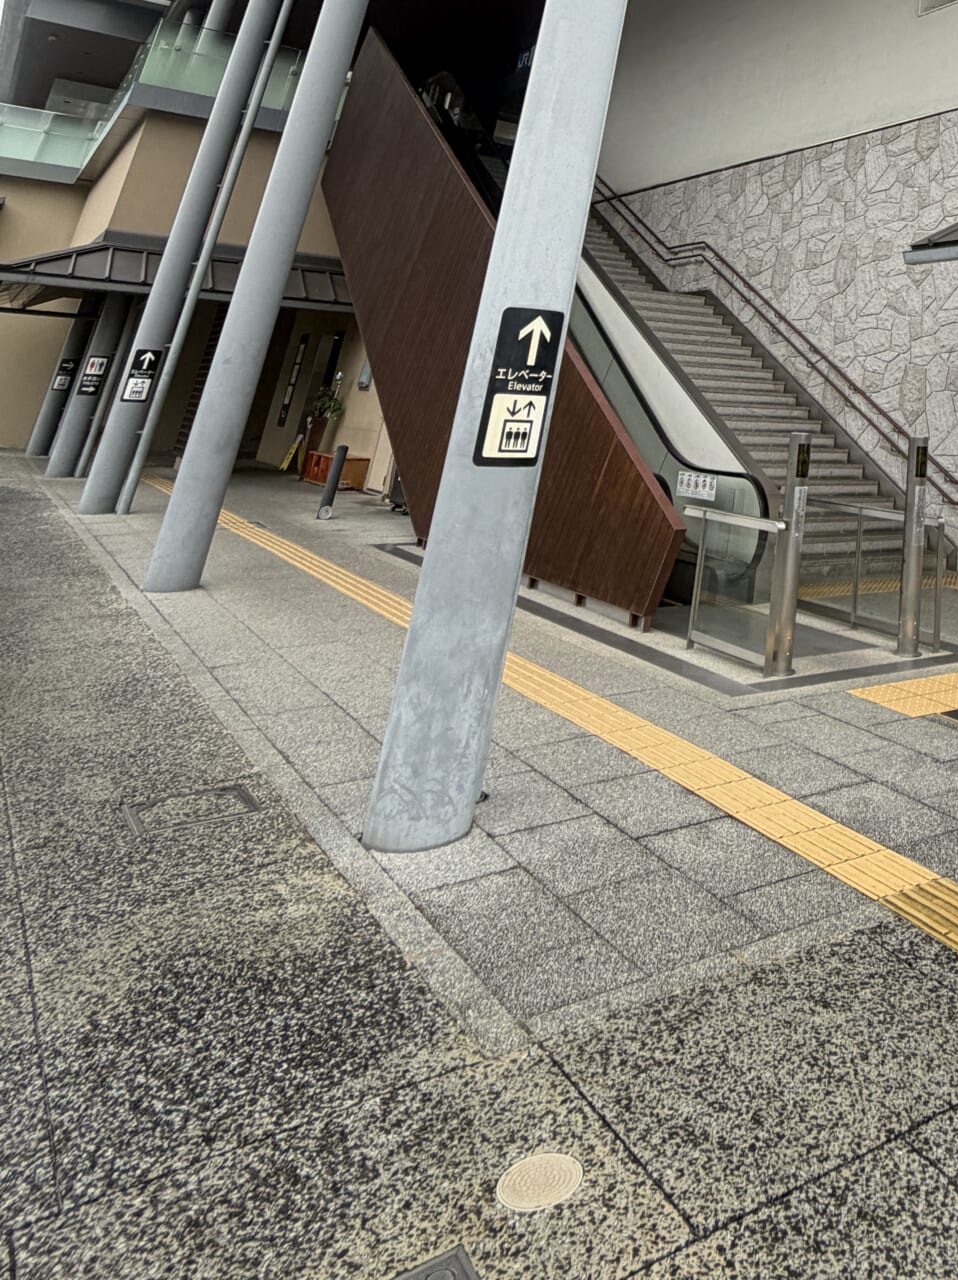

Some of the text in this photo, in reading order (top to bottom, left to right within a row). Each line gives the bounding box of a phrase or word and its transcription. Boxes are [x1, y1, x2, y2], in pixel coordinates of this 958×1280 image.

[495, 368, 552, 382] エレベーター
[507, 381, 543, 392] Elevator
